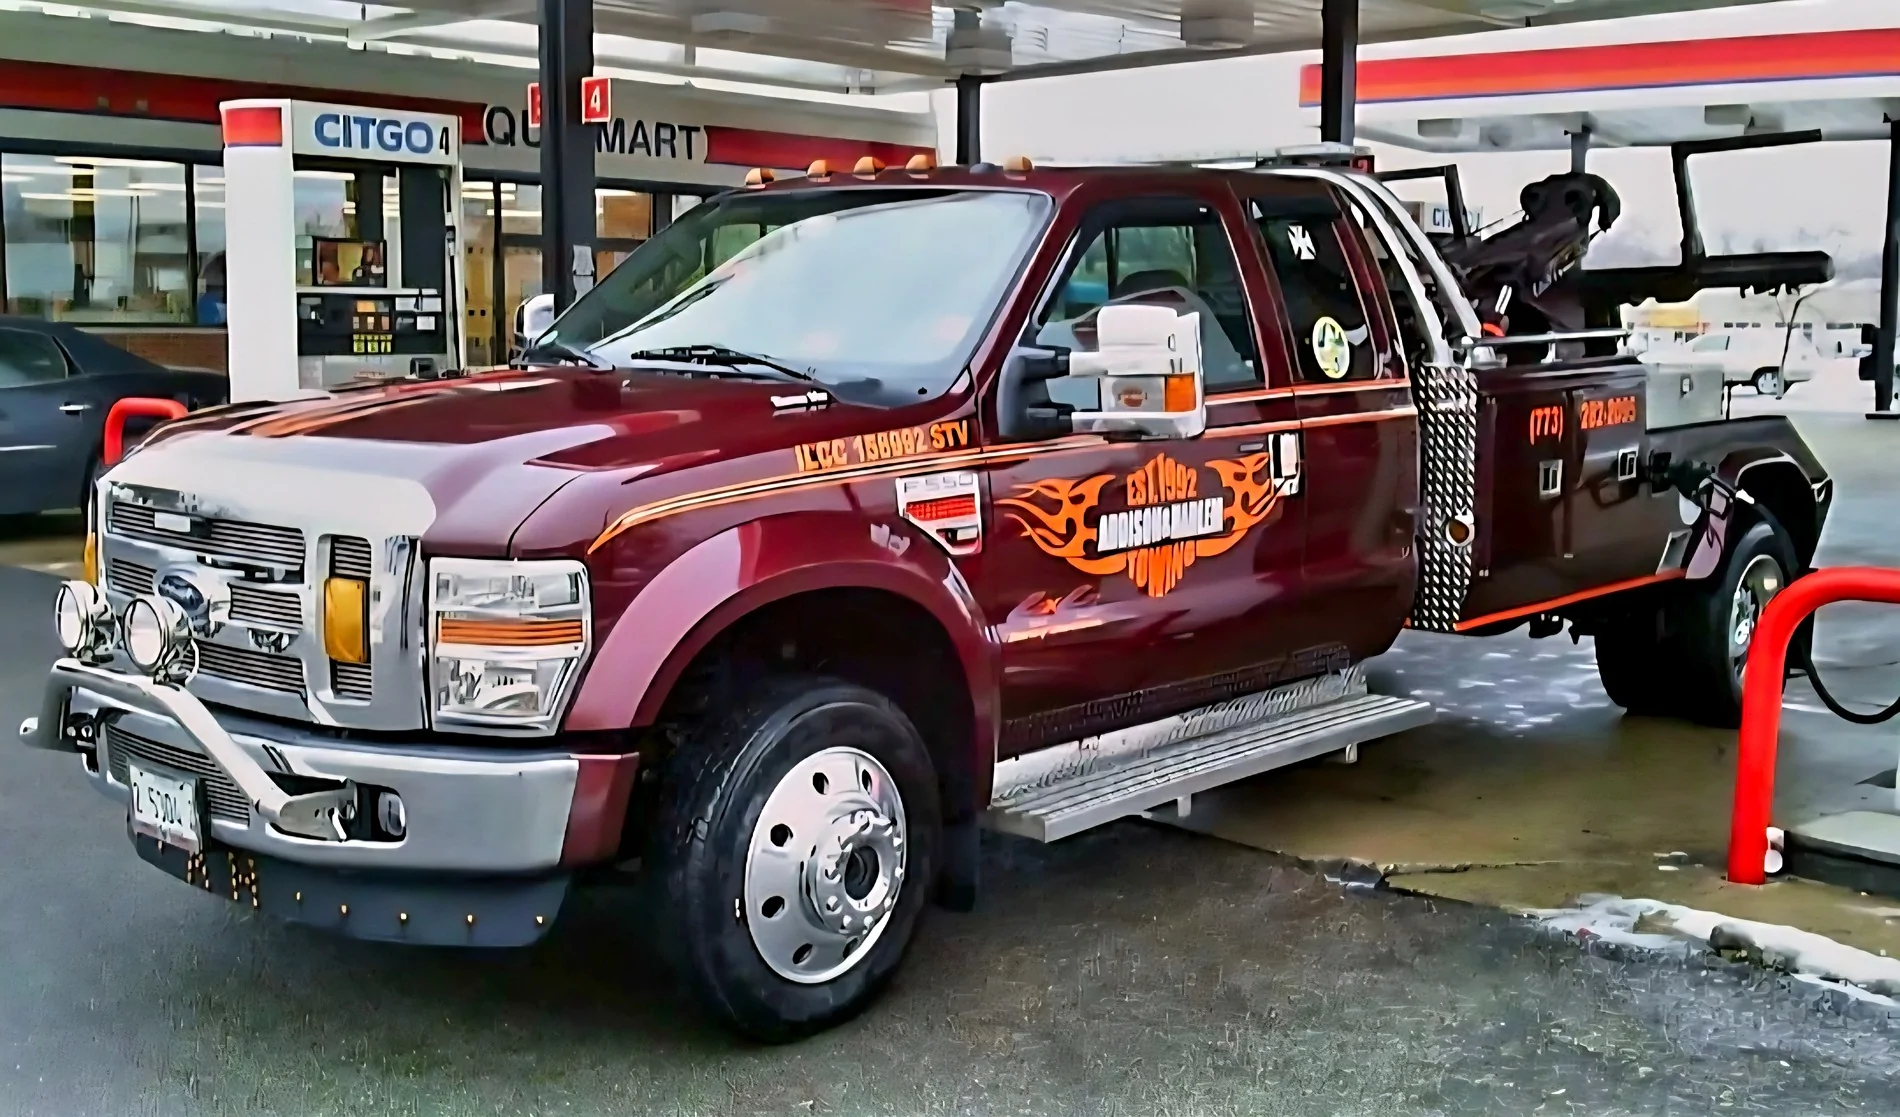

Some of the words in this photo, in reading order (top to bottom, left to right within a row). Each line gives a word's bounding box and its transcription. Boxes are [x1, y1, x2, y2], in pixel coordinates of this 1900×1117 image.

[590, 86, 601, 112] 4
[314, 113, 434, 154] CITGO
[439, 126, 450, 156] 4
[596, 117, 701, 160] MART
[930, 419, 968, 449] STV
[1529, 405, 1564, 446] (773)
